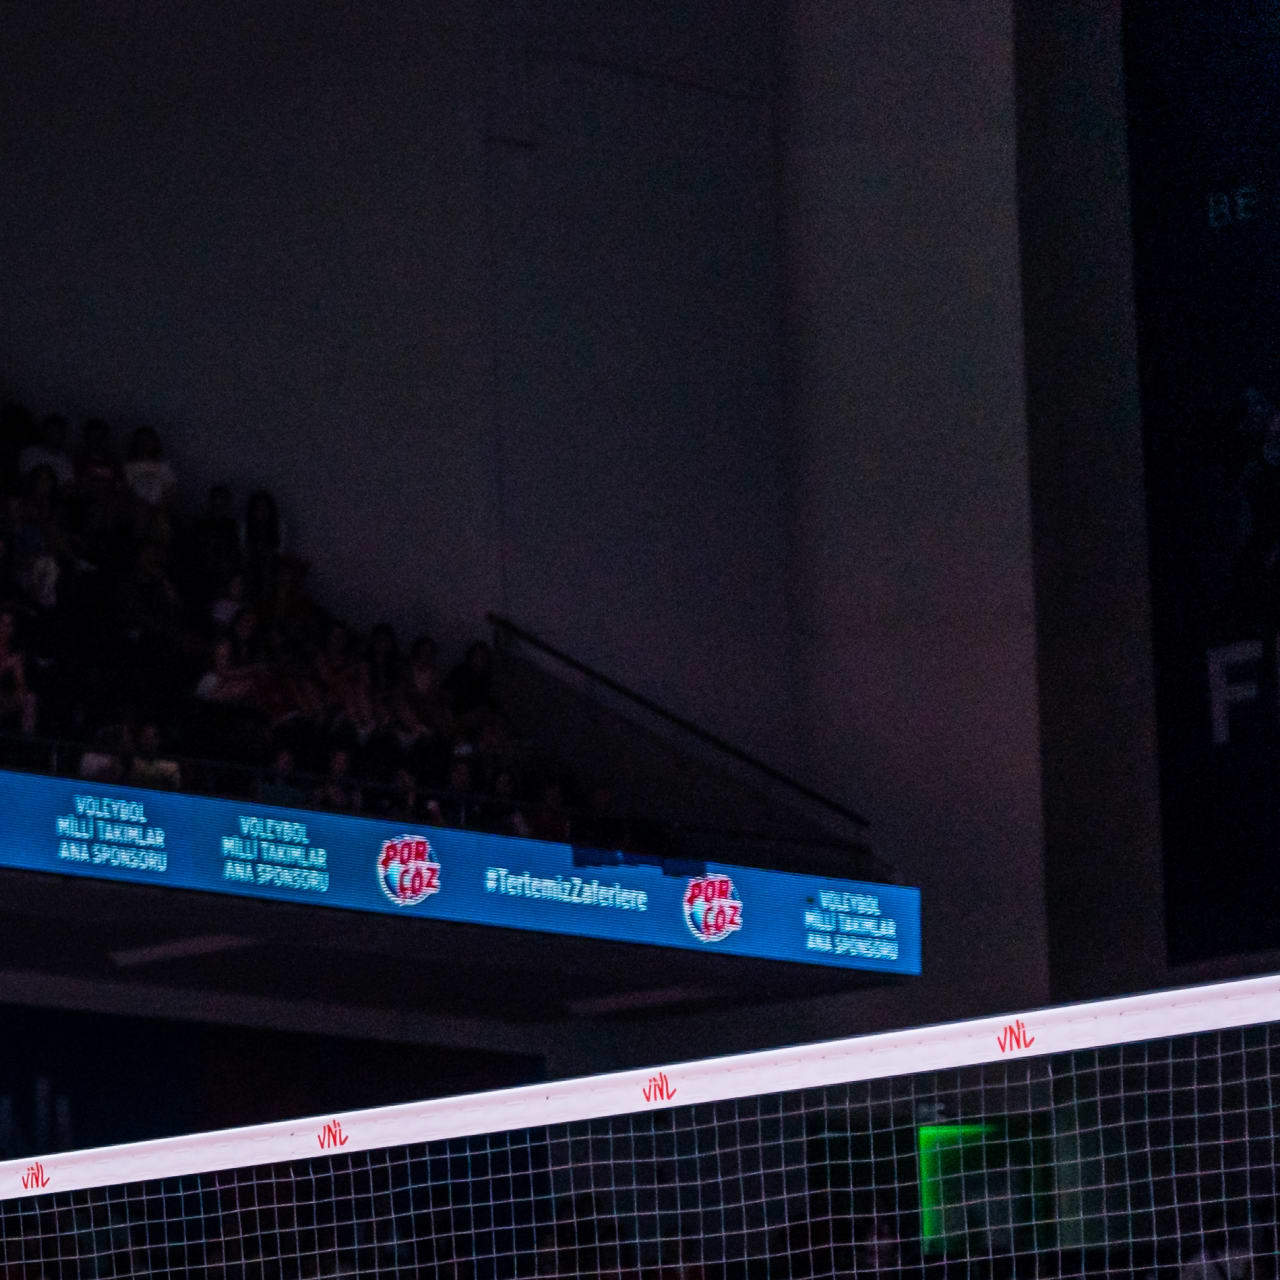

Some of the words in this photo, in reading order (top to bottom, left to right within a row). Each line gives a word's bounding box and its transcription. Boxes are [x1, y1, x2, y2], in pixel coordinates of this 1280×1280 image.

[998, 1019, 1035, 1052] VNL
[643, 1072, 676, 1102] VNL
[318, 1119, 349, 1149] VNL
[22, 1162, 50, 1189] VNL
